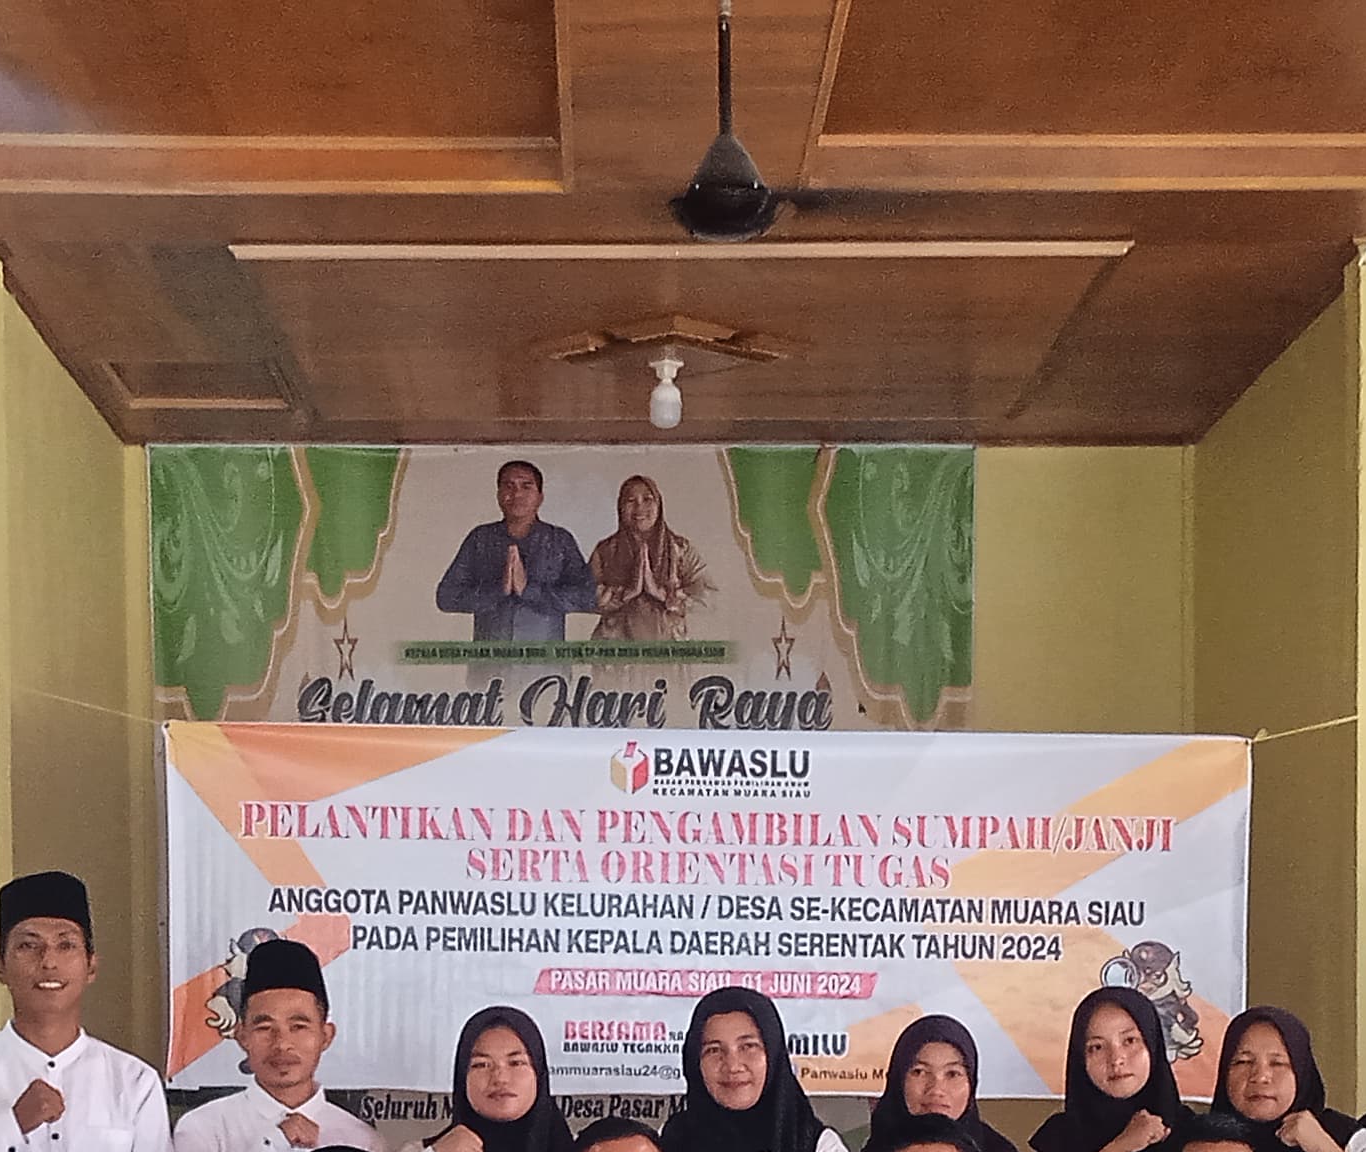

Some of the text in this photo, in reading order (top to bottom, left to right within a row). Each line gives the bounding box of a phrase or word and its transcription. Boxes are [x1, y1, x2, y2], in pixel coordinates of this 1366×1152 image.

[298, 675, 834, 730] Selamat Hari Raya
[654, 748, 810, 779] BAWASLU
[652, 787, 811, 798] KECAMATAN MUARA SIAU
[241, 803, 1176, 853] PELANTIKAN DAN PENGAMBILAN SUMPAH/JANJI
[467, 848, 951, 889] SERTA ORIENTASI TUGAS
[269, 888, 1145, 926] ANGGOTA PANWASLU KELURAHAN / DESA SE-KECAMATAN MUARA SIAU
[352, 926, 1062, 961] PADA PEMILIHAN KEPALA DAERAH SERENTAK TAHUN 2024
[550, 970, 610, 991] PASAR
[616, 971, 682, 992] MUARA
[741, 973, 762, 992] 01
[769, 973, 812, 994] JUNI
[817, 974, 861, 994] 2024
[564, 1021, 667, 1041] BERSAMA
[563, 1042, 680, 1054] BAWASLU TEGAKKA
[788, 1034, 847, 1056] MILU
[362, 1093, 437, 1120] Seluruh
[561, 1096, 605, 1118] Desa
[609, 1095, 665, 1118] Pasar
